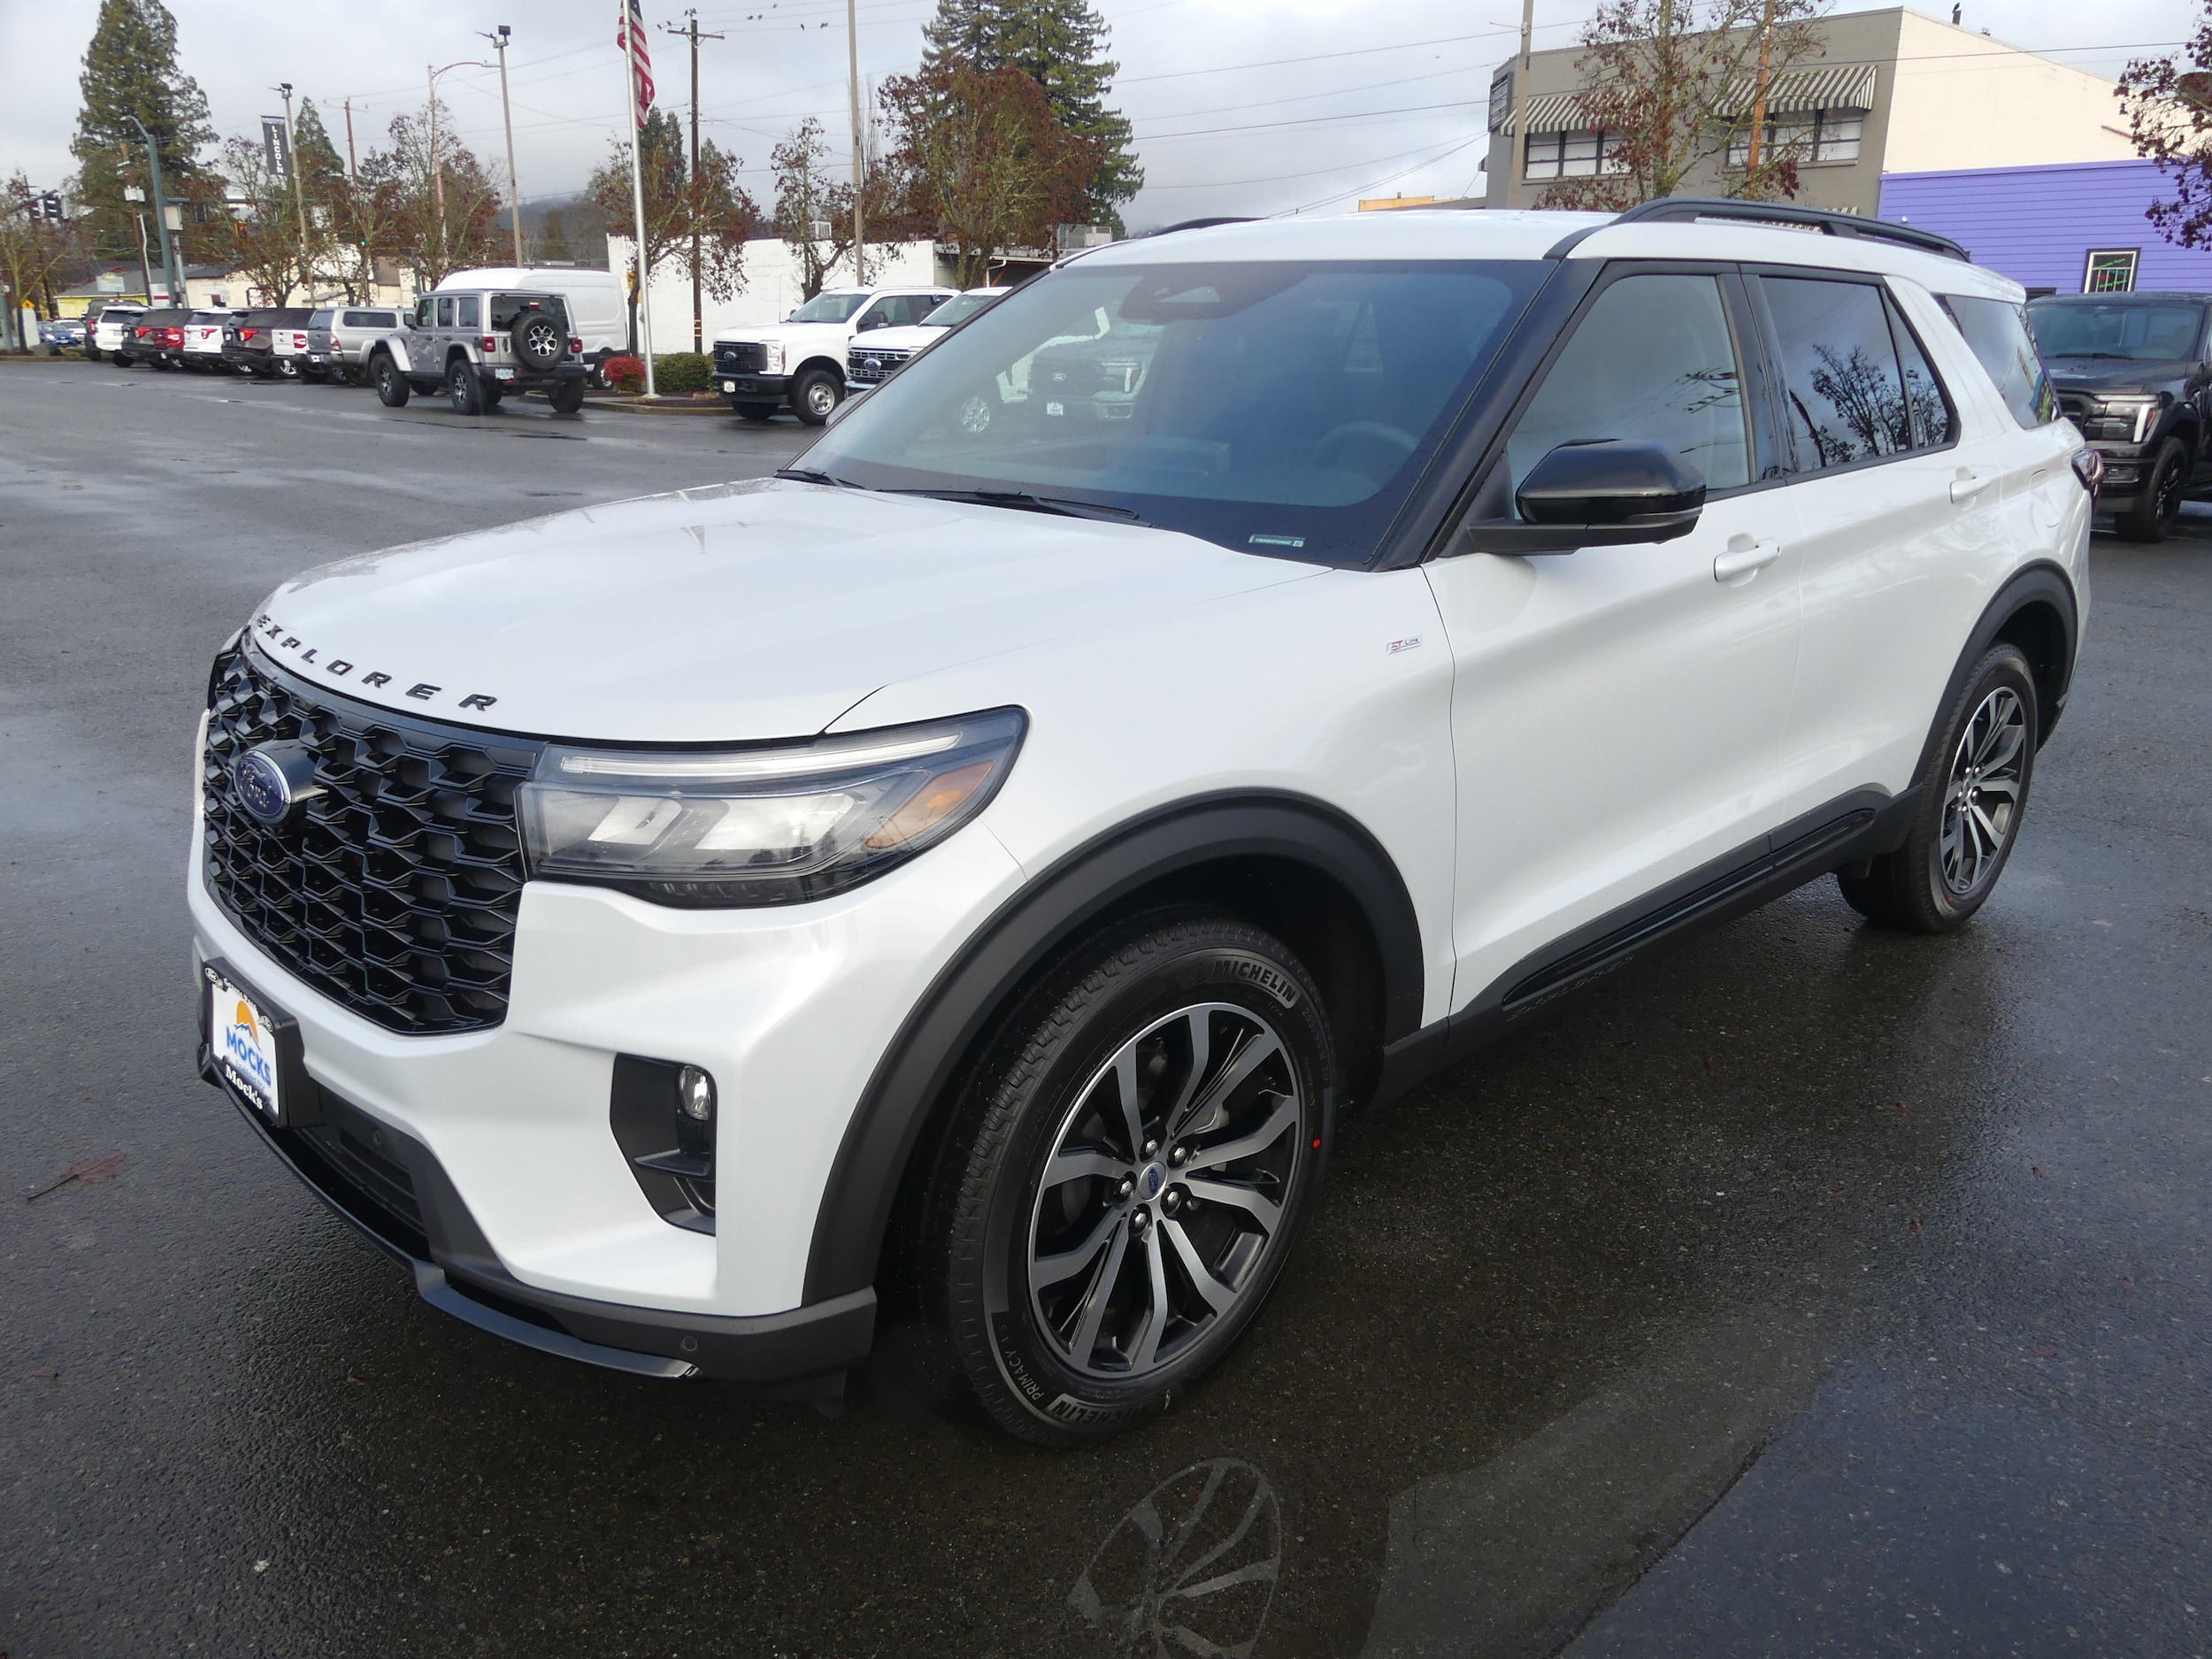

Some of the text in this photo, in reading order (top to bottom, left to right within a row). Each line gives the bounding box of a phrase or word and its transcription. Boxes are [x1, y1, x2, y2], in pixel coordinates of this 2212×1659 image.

[272, 125, 284, 173] LINCOLN
[257, 614, 497, 711] EXPLORER
[240, 759, 272, 809] Ford
[1214, 960, 1297, 1003] MICHELIN
[226, 1025, 272, 1087] MOCKS
[225, 1064, 264, 1110] Mock's
[1005, 1349, 1045, 1401] PRIMACY
